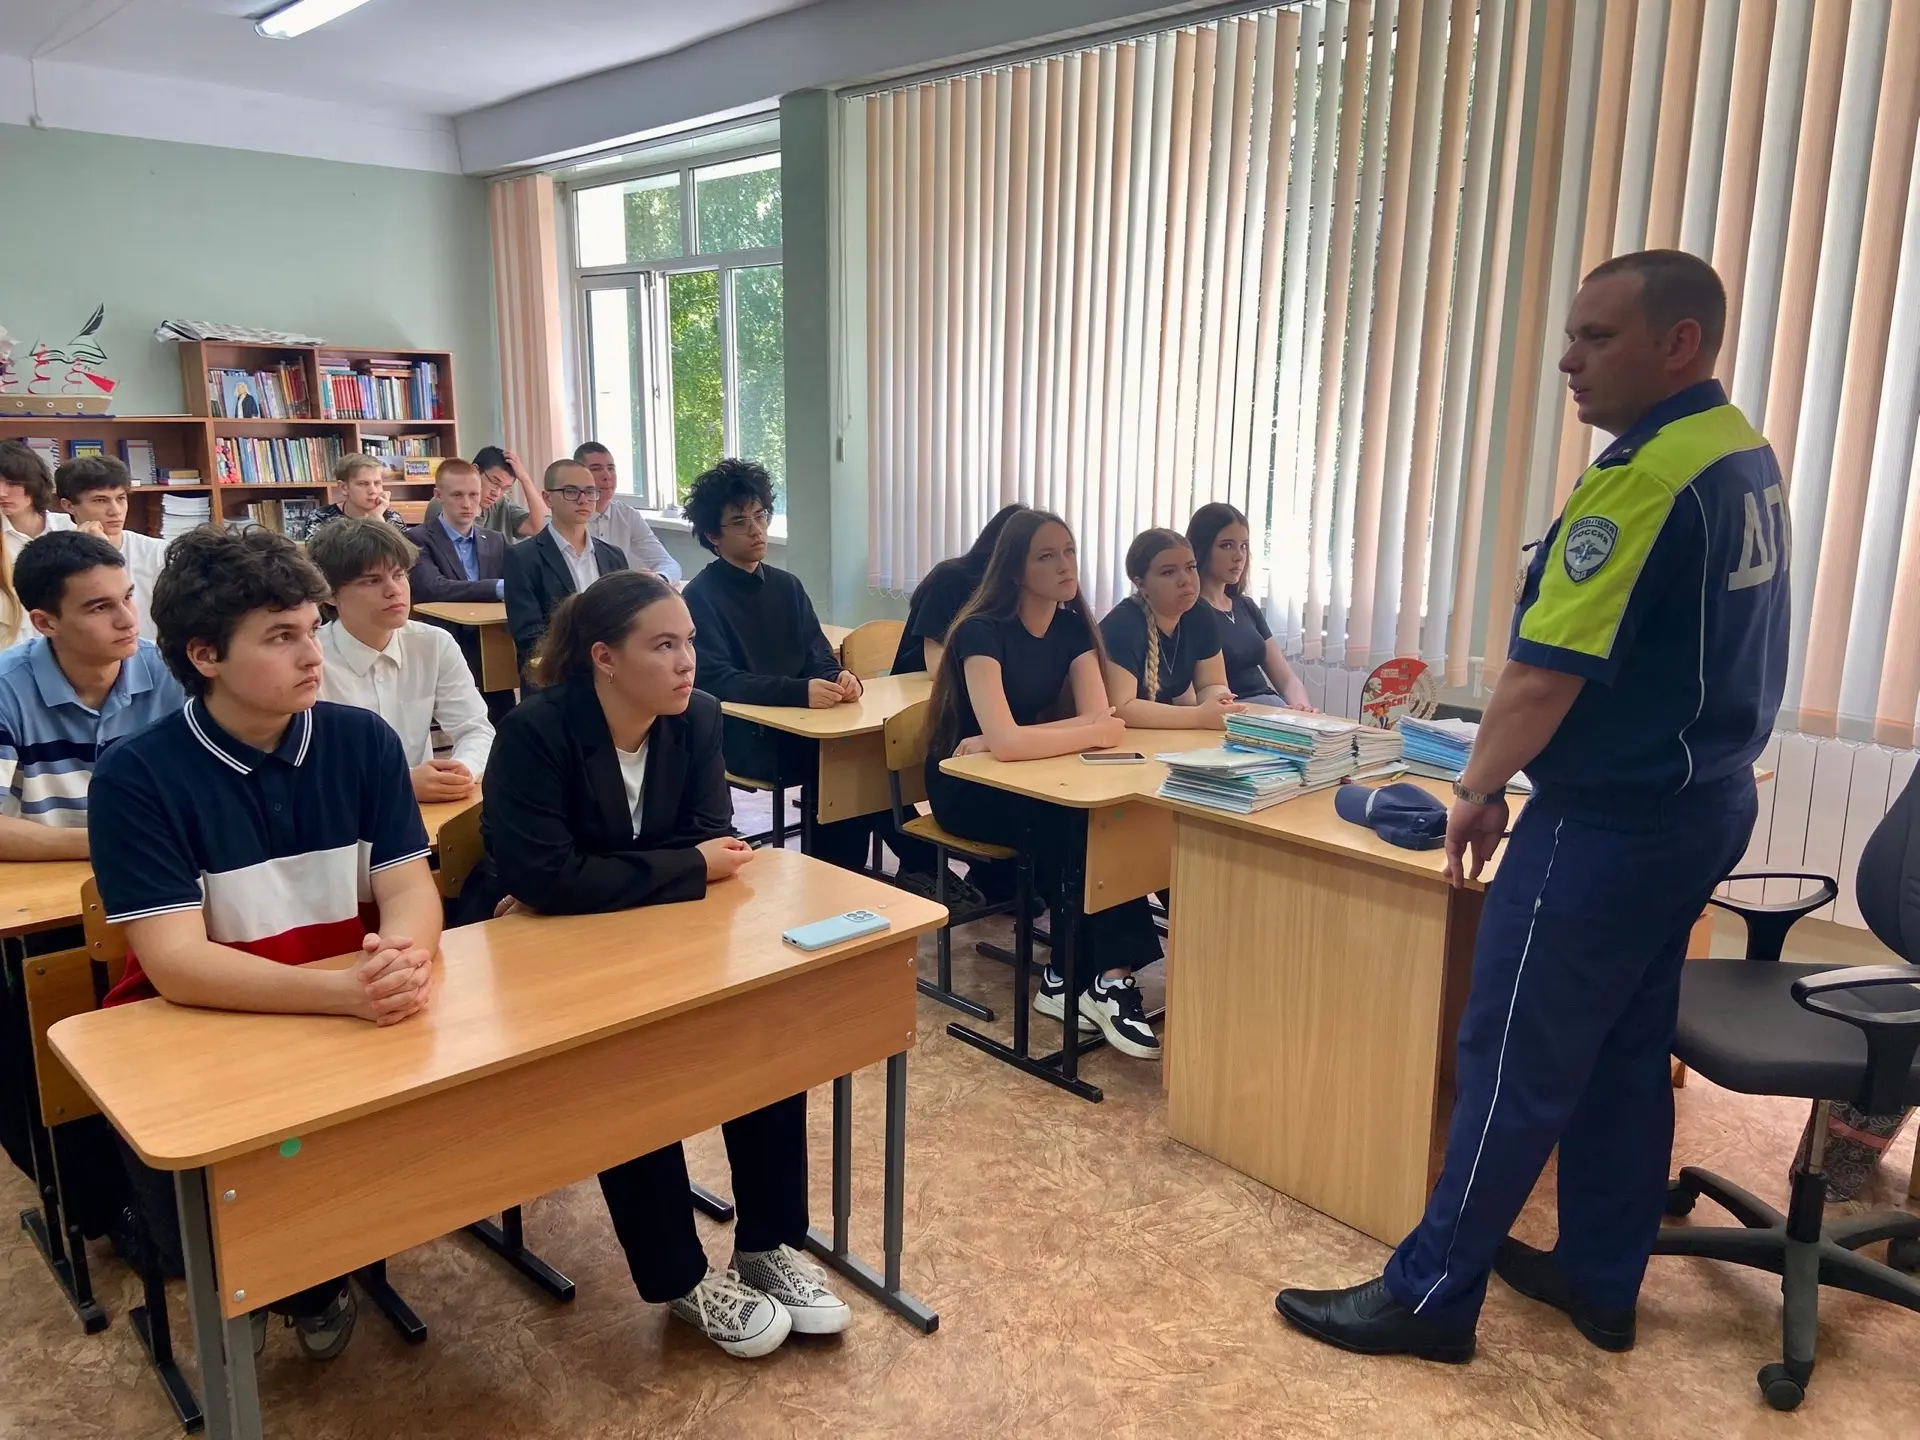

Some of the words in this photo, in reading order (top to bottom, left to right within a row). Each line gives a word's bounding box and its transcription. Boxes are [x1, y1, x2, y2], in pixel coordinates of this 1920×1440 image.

[1572, 517, 1615, 535] ПОЛИЦИЯ
[1571, 529, 1608, 546] РОССИЯ
[1728, 481, 1791, 591] ДП
[1569, 569, 1588, 581] МВД
